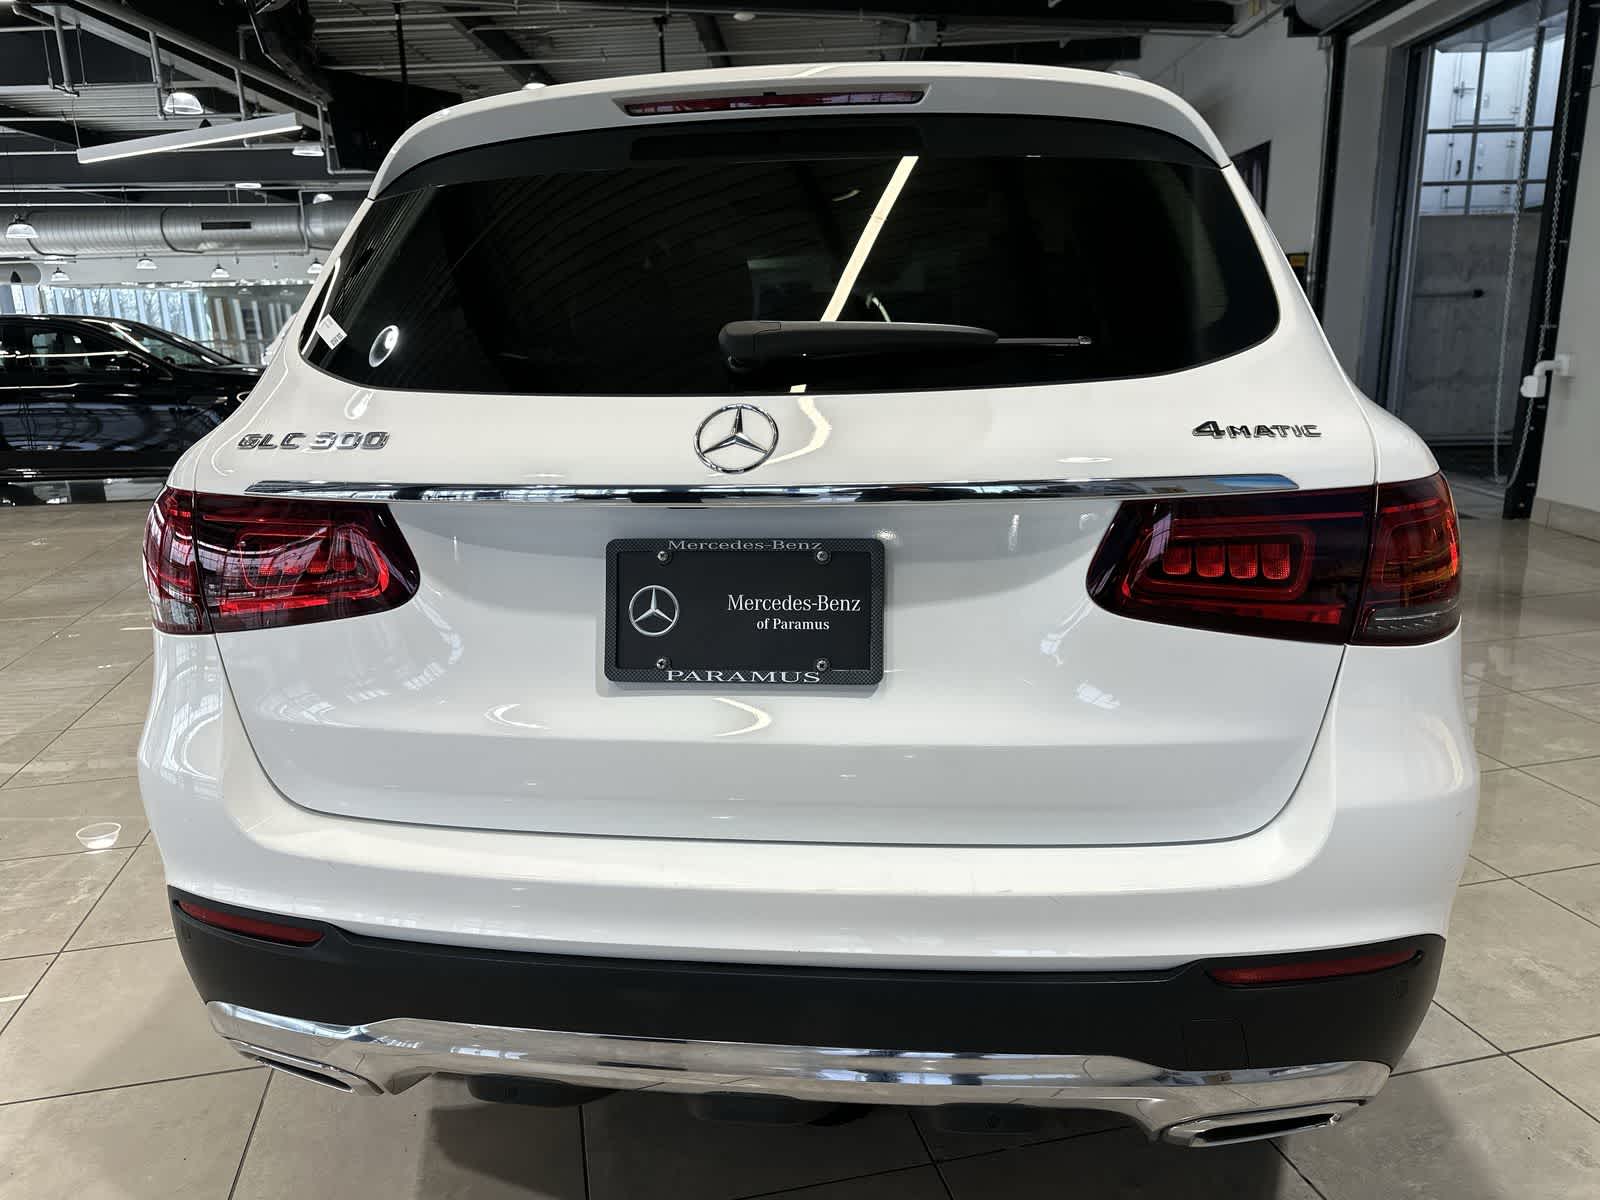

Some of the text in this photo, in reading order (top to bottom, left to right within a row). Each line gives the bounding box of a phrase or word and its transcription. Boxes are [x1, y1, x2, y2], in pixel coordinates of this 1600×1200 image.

[1192, 420, 1322, 439] 4MATIC
[237, 431, 391, 450] GLC 300
[668, 539, 823, 550] Mercedes-Benz
[727, 594, 861, 612] Mercedes-Benz
[756, 618, 830, 630] of Paramus
[667, 670, 821, 683] PARAMUS
